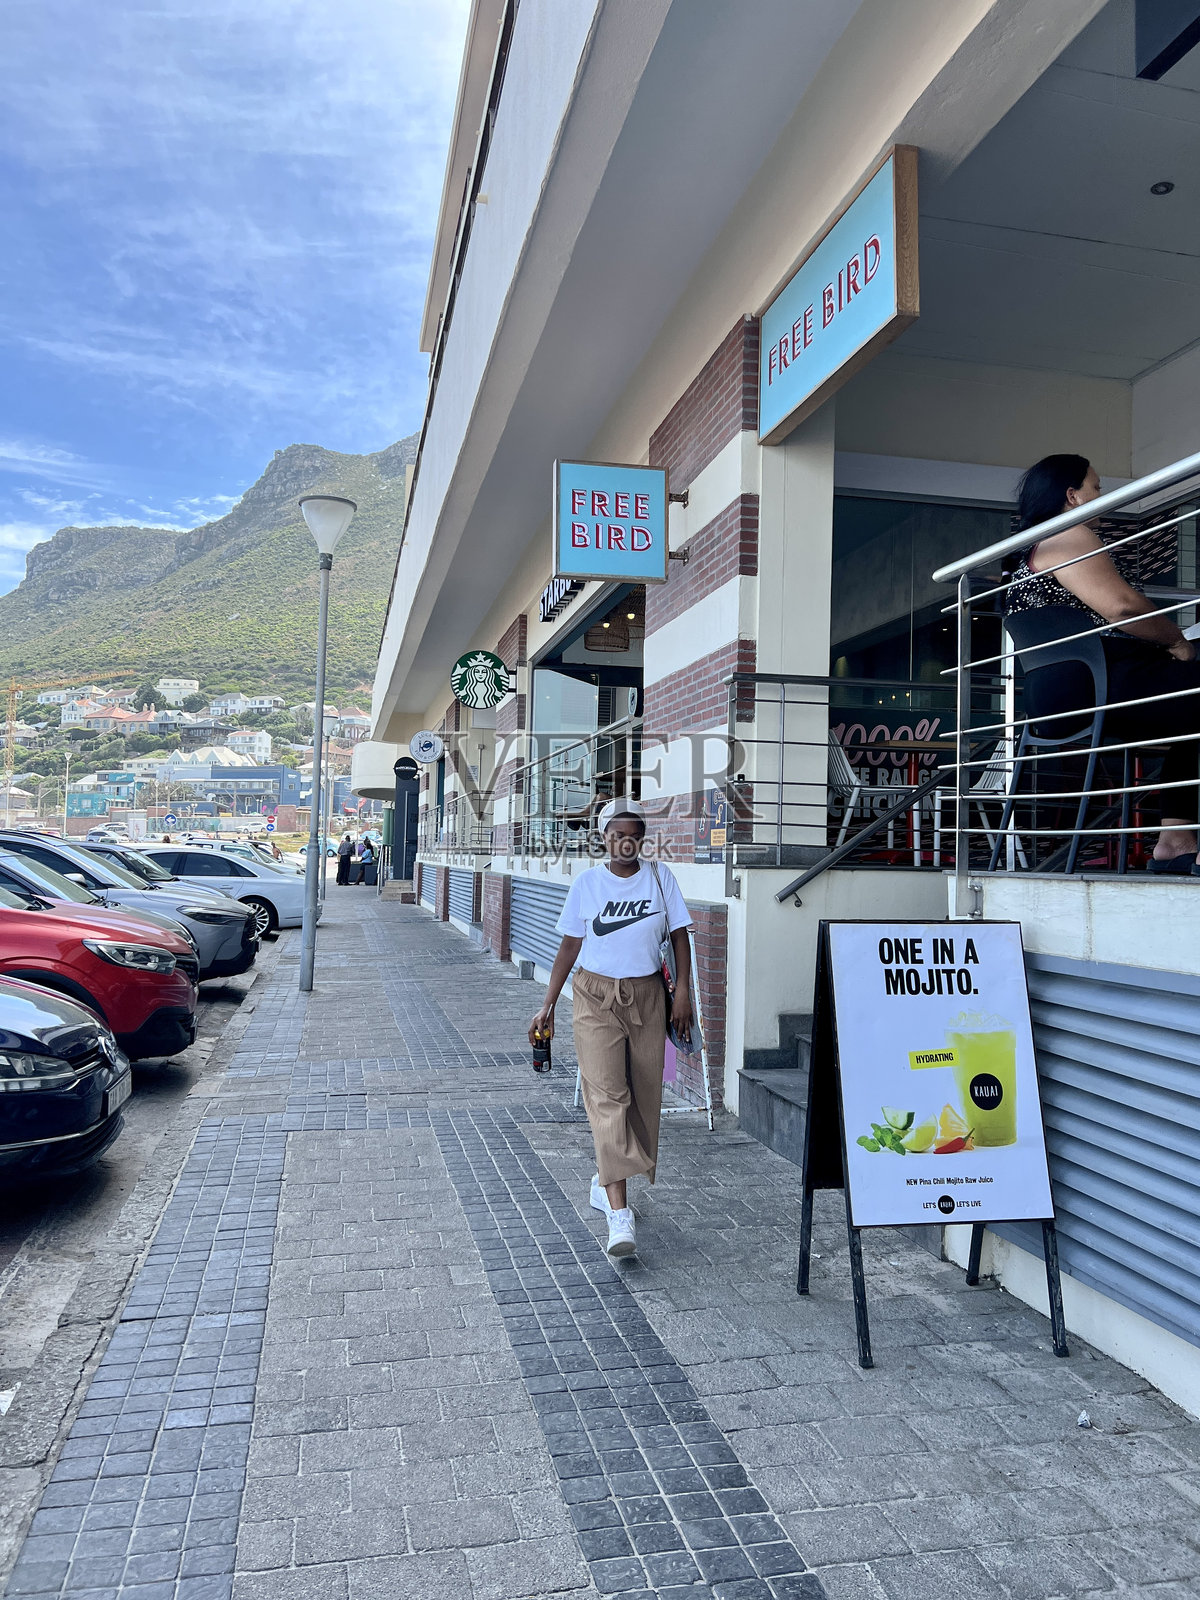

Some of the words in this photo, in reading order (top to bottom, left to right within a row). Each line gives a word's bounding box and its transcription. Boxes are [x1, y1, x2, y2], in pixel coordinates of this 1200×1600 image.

[768, 303, 814, 386] FREE
[822, 233, 881, 329] BIRD
[571, 488, 650, 520] FREE
[571, 521, 653, 552] BIRD
[601, 899, 652, 917] NIKE
[878, 938, 924, 965] ONE
[932, 938, 955, 965] IN
[964, 938, 980, 965] A
[884, 968, 979, 996] MOJITO.
[915, 1052, 954, 1065] HYDRATING
[973, 1085, 999, 1098] KAUAI
[906, 1178, 918, 1186] NEW
[946, 1176, 964, 1186] Mojito
